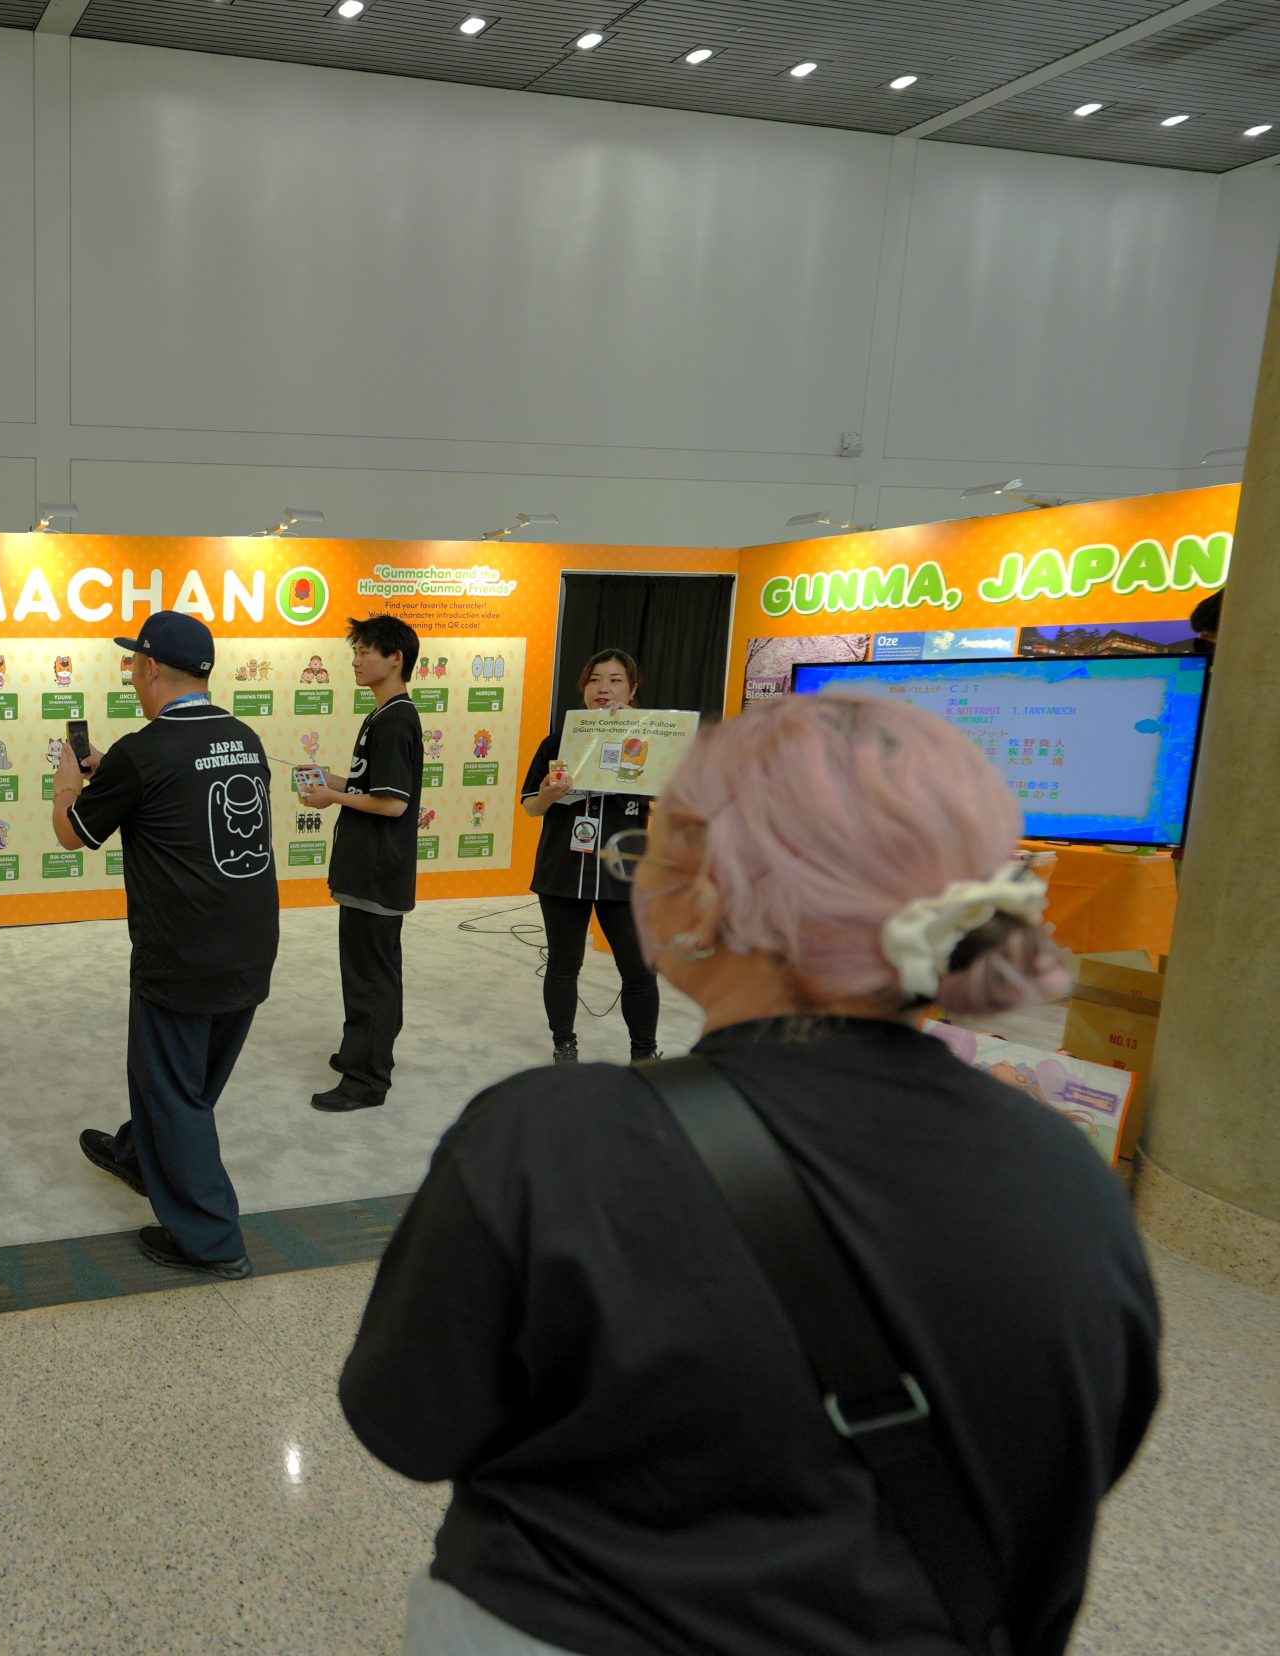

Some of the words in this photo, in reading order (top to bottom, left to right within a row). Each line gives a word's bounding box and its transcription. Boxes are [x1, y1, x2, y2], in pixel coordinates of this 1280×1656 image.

[455, 567, 476, 579] and
[479, 567, 498, 579] the
[761, 560, 962, 617] GUNMA,
[979, 531, 1235, 603] JAPAN
[359, 581, 414, 596] Hiragana
[420, 601, 447, 609] favorite
[449, 601, 487, 609] character!
[436, 611, 480, 619] introduction
[481, 611, 500, 619] video
[409, 622, 432, 630] anning
[460, 621, 481, 629] code!
[877, 636, 898, 647] Oze
[746, 680, 777, 692] Cherry
[745, 690, 783, 700] Blossom
[650, 720, 677, 728] Follow
[642, 728, 686, 737] Instagram
[210, 740, 244, 755] JAPAN
[195, 752, 260, 771] GUNMACHAN
